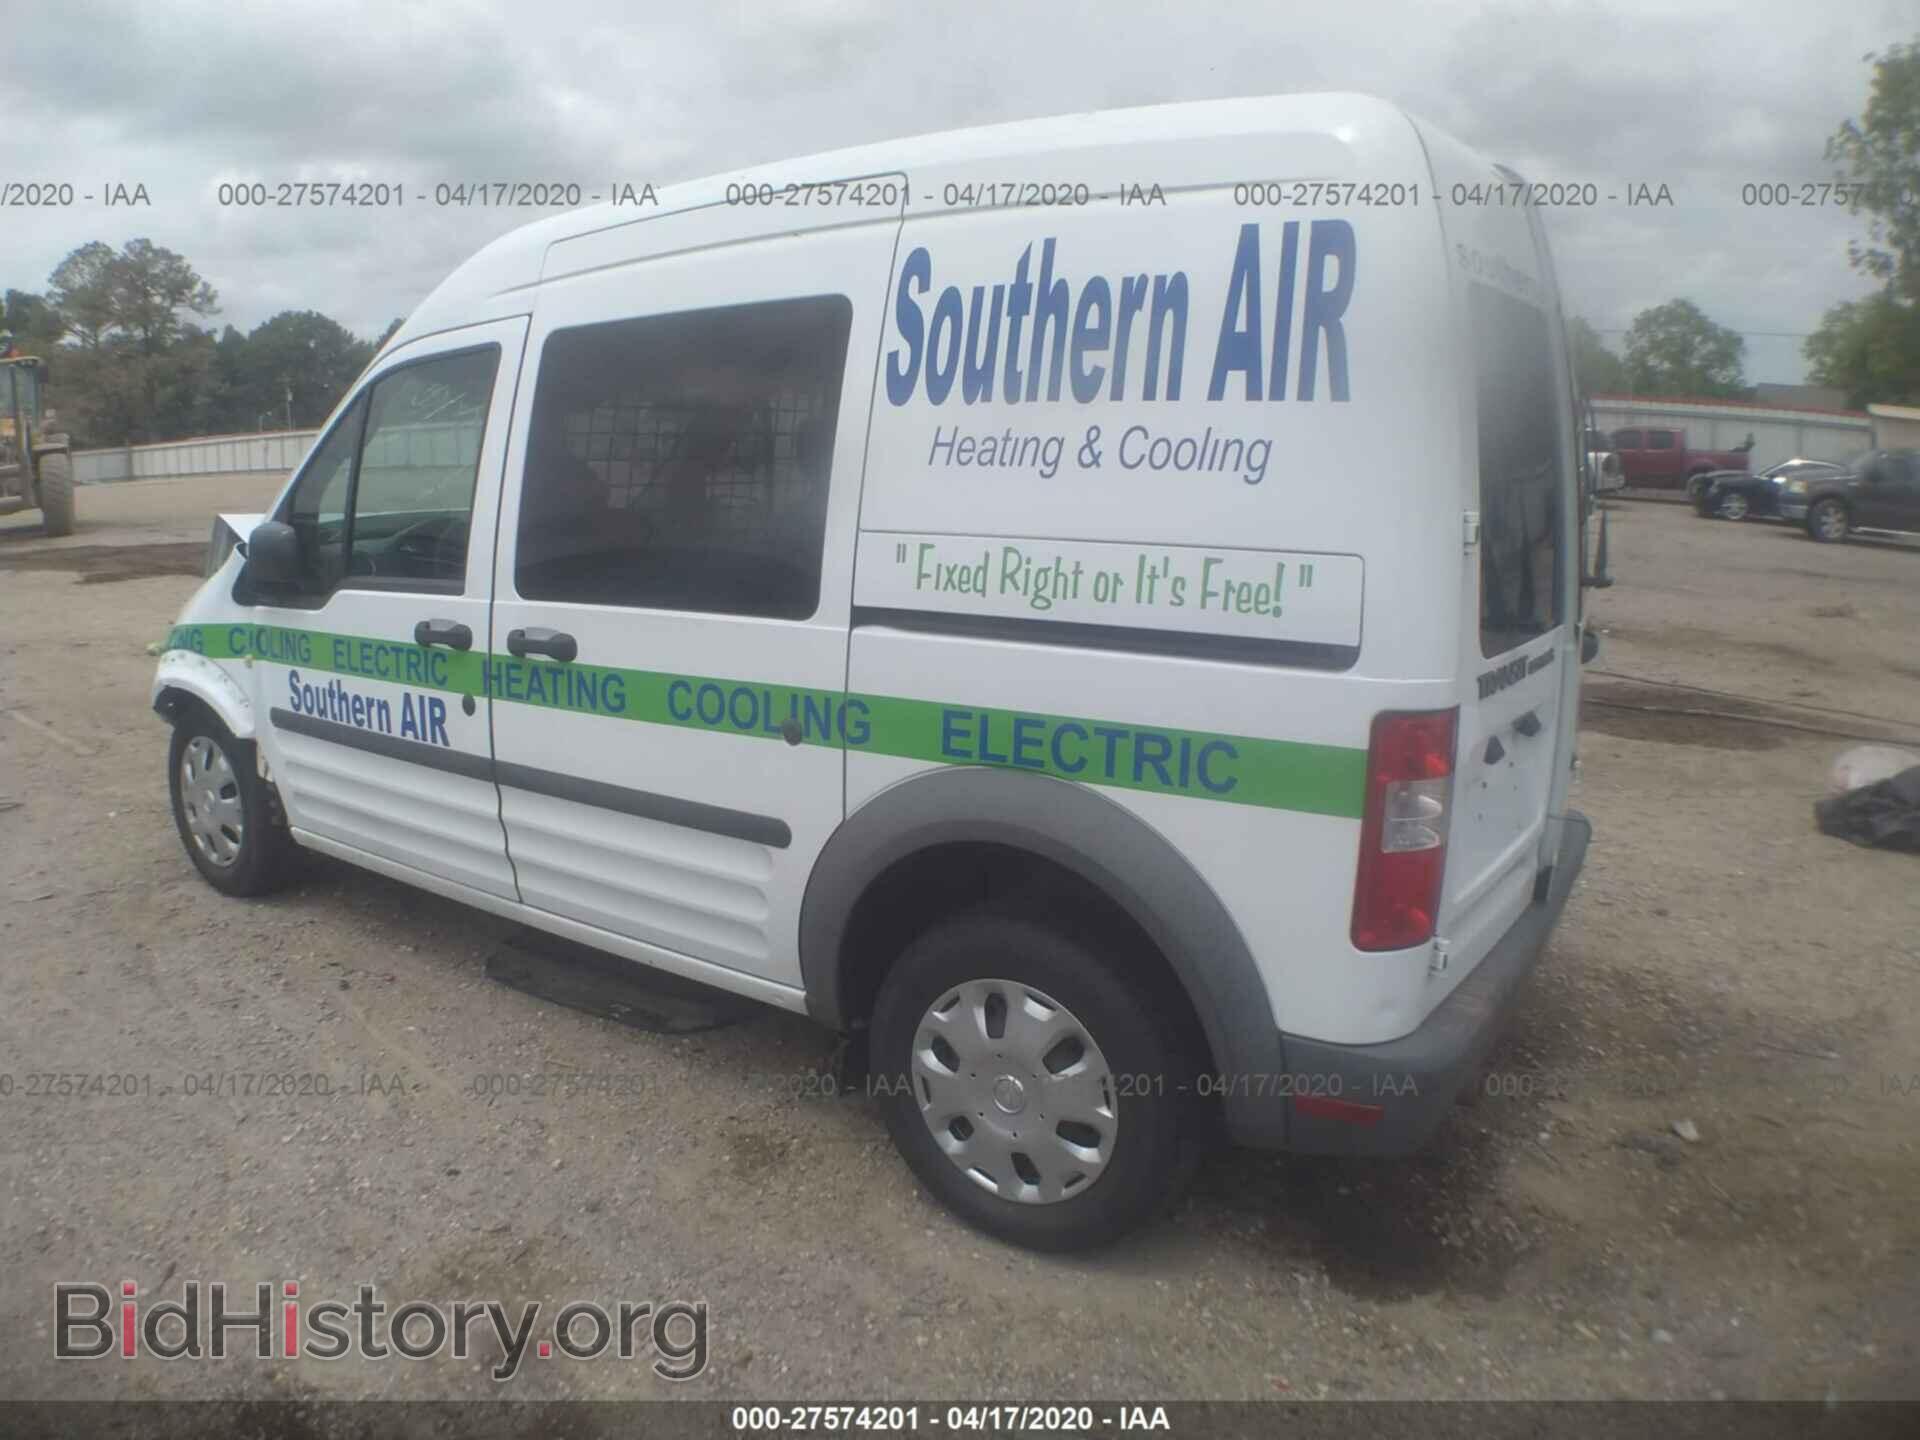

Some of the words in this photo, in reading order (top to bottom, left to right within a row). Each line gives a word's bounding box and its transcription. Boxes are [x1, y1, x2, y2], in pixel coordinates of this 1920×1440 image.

[886, 235, 1190, 407] Southern
[1207, 218, 1357, 403] AIR
[928, 424, 1065, 480] Heating
[1077, 424, 1103, 470] &
[1118, 425, 1273, 486] Cooling
[999, 545, 1084, 611] Right
[1092, 569, 1125, 603] or
[1135, 554, 1186, 607] It's
[333, 639, 449, 687] ELECTRIC
[288, 669, 392, 733] Southern
[400, 692, 450, 747] AIR
[482, 660, 627, 713] HEATING
[667, 679, 871, 746] COOLING
[940, 709, 1239, 795] ELECTRIC
